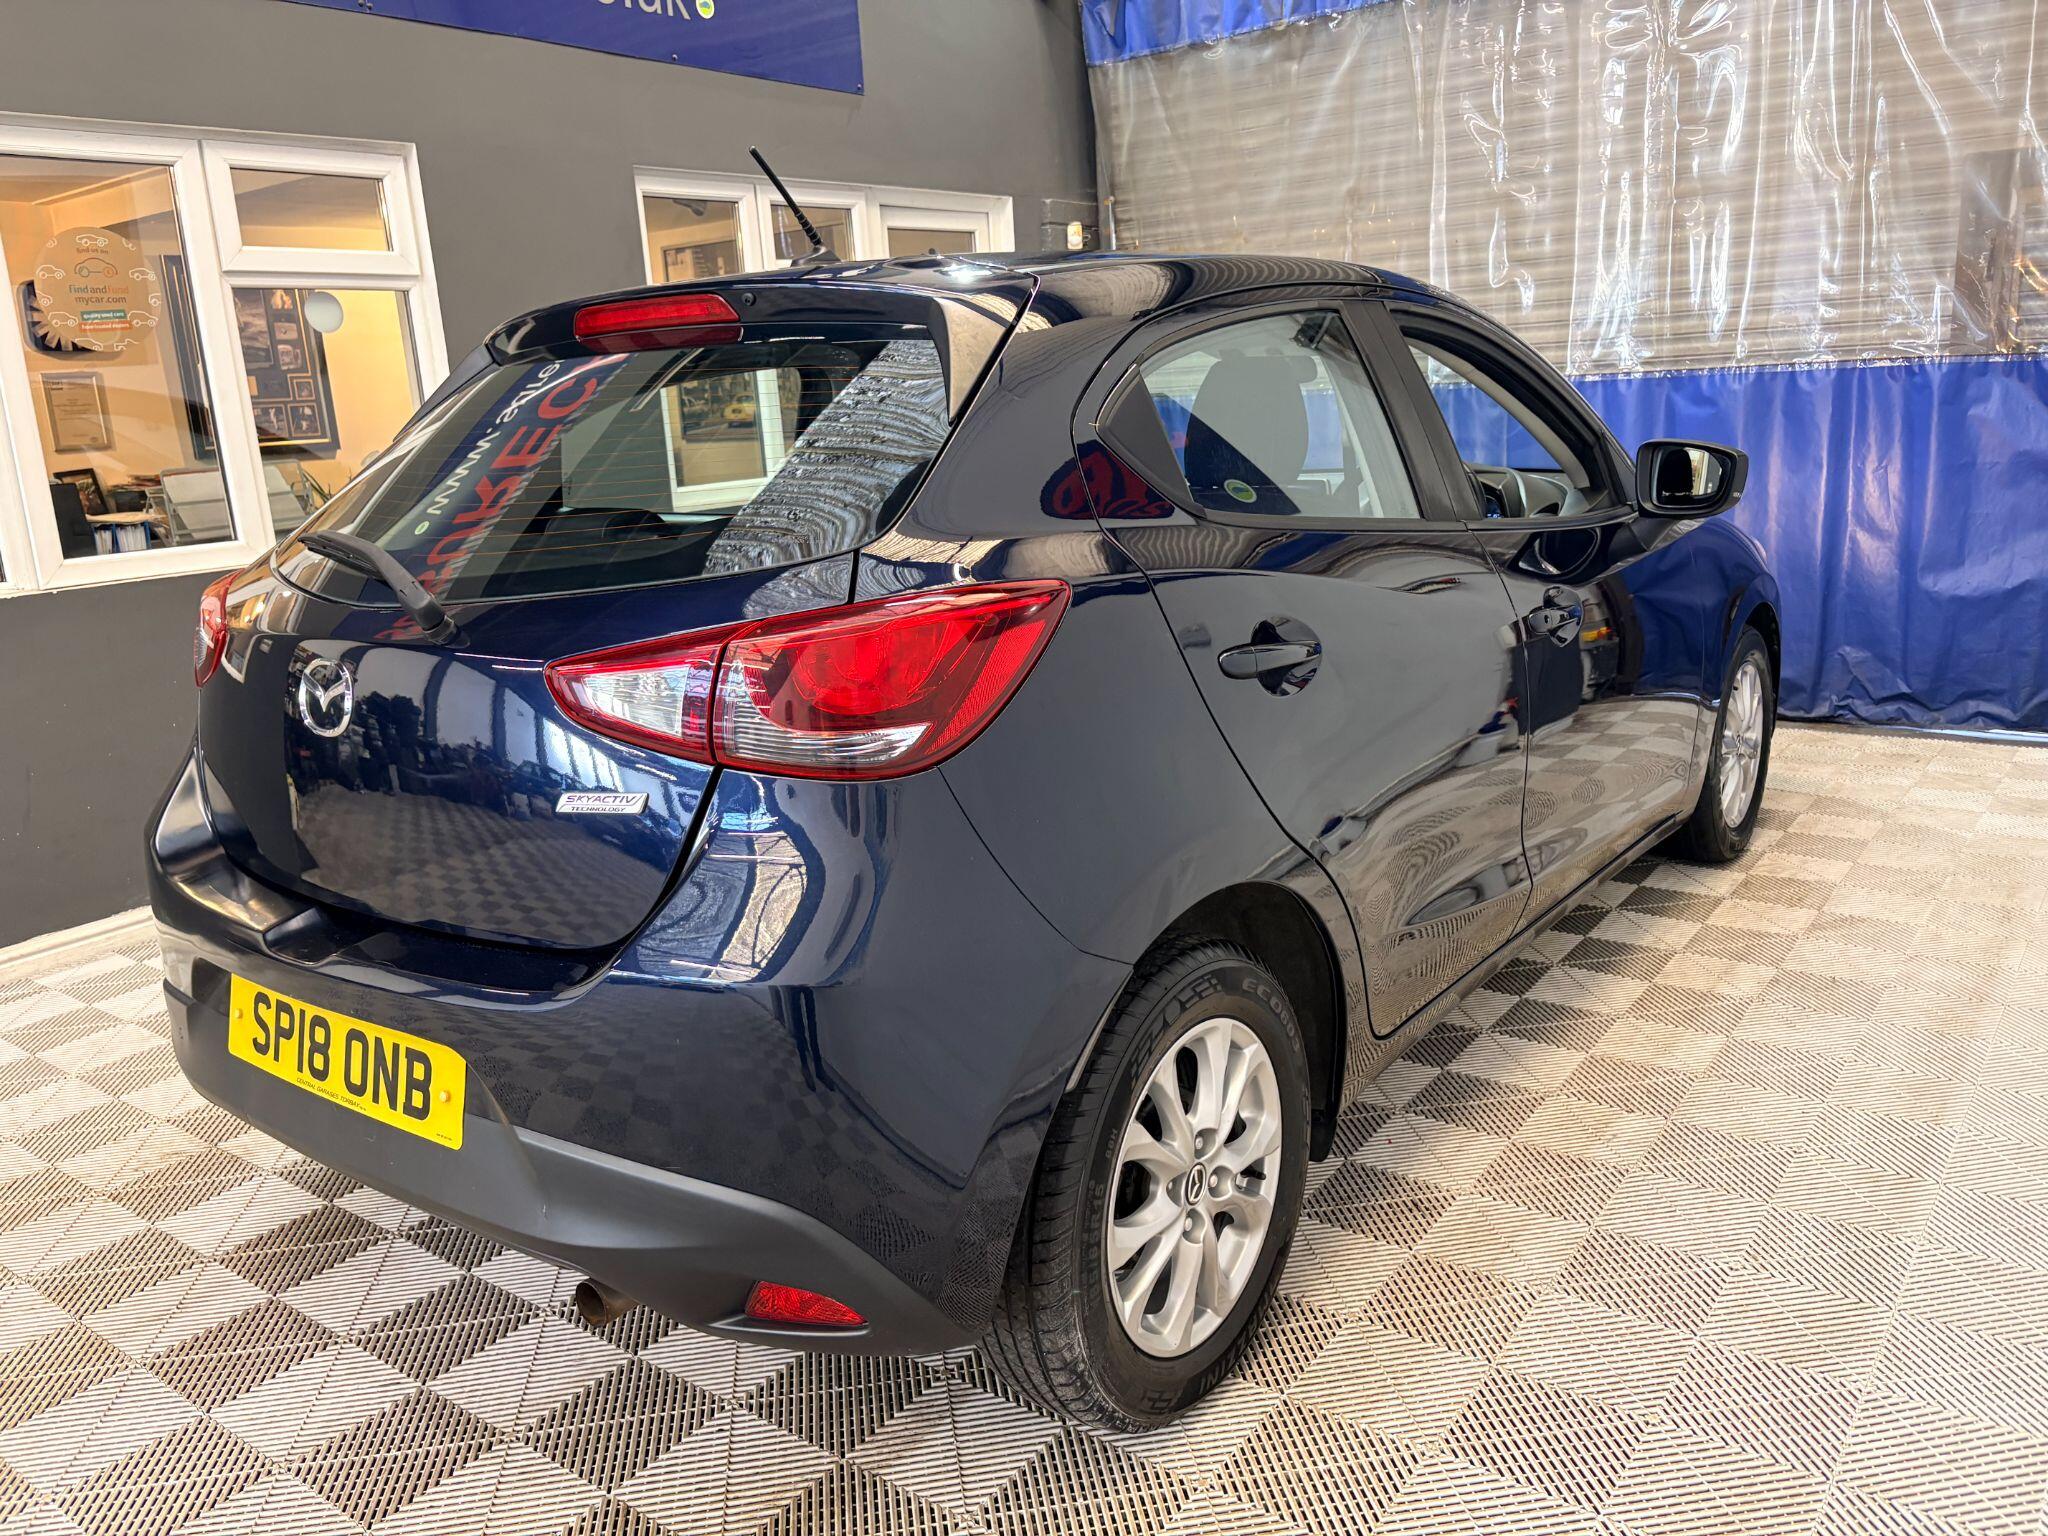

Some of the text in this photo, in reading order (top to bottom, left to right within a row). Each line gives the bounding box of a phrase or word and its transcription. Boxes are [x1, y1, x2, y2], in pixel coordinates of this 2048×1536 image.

[74, 295, 127, 305] mycar.com
[565, 795, 637, 804] SKYACTIV
[252, 991, 432, 1121] SP18 ONB
[296, 1077, 316, 1089] CENTRAL
